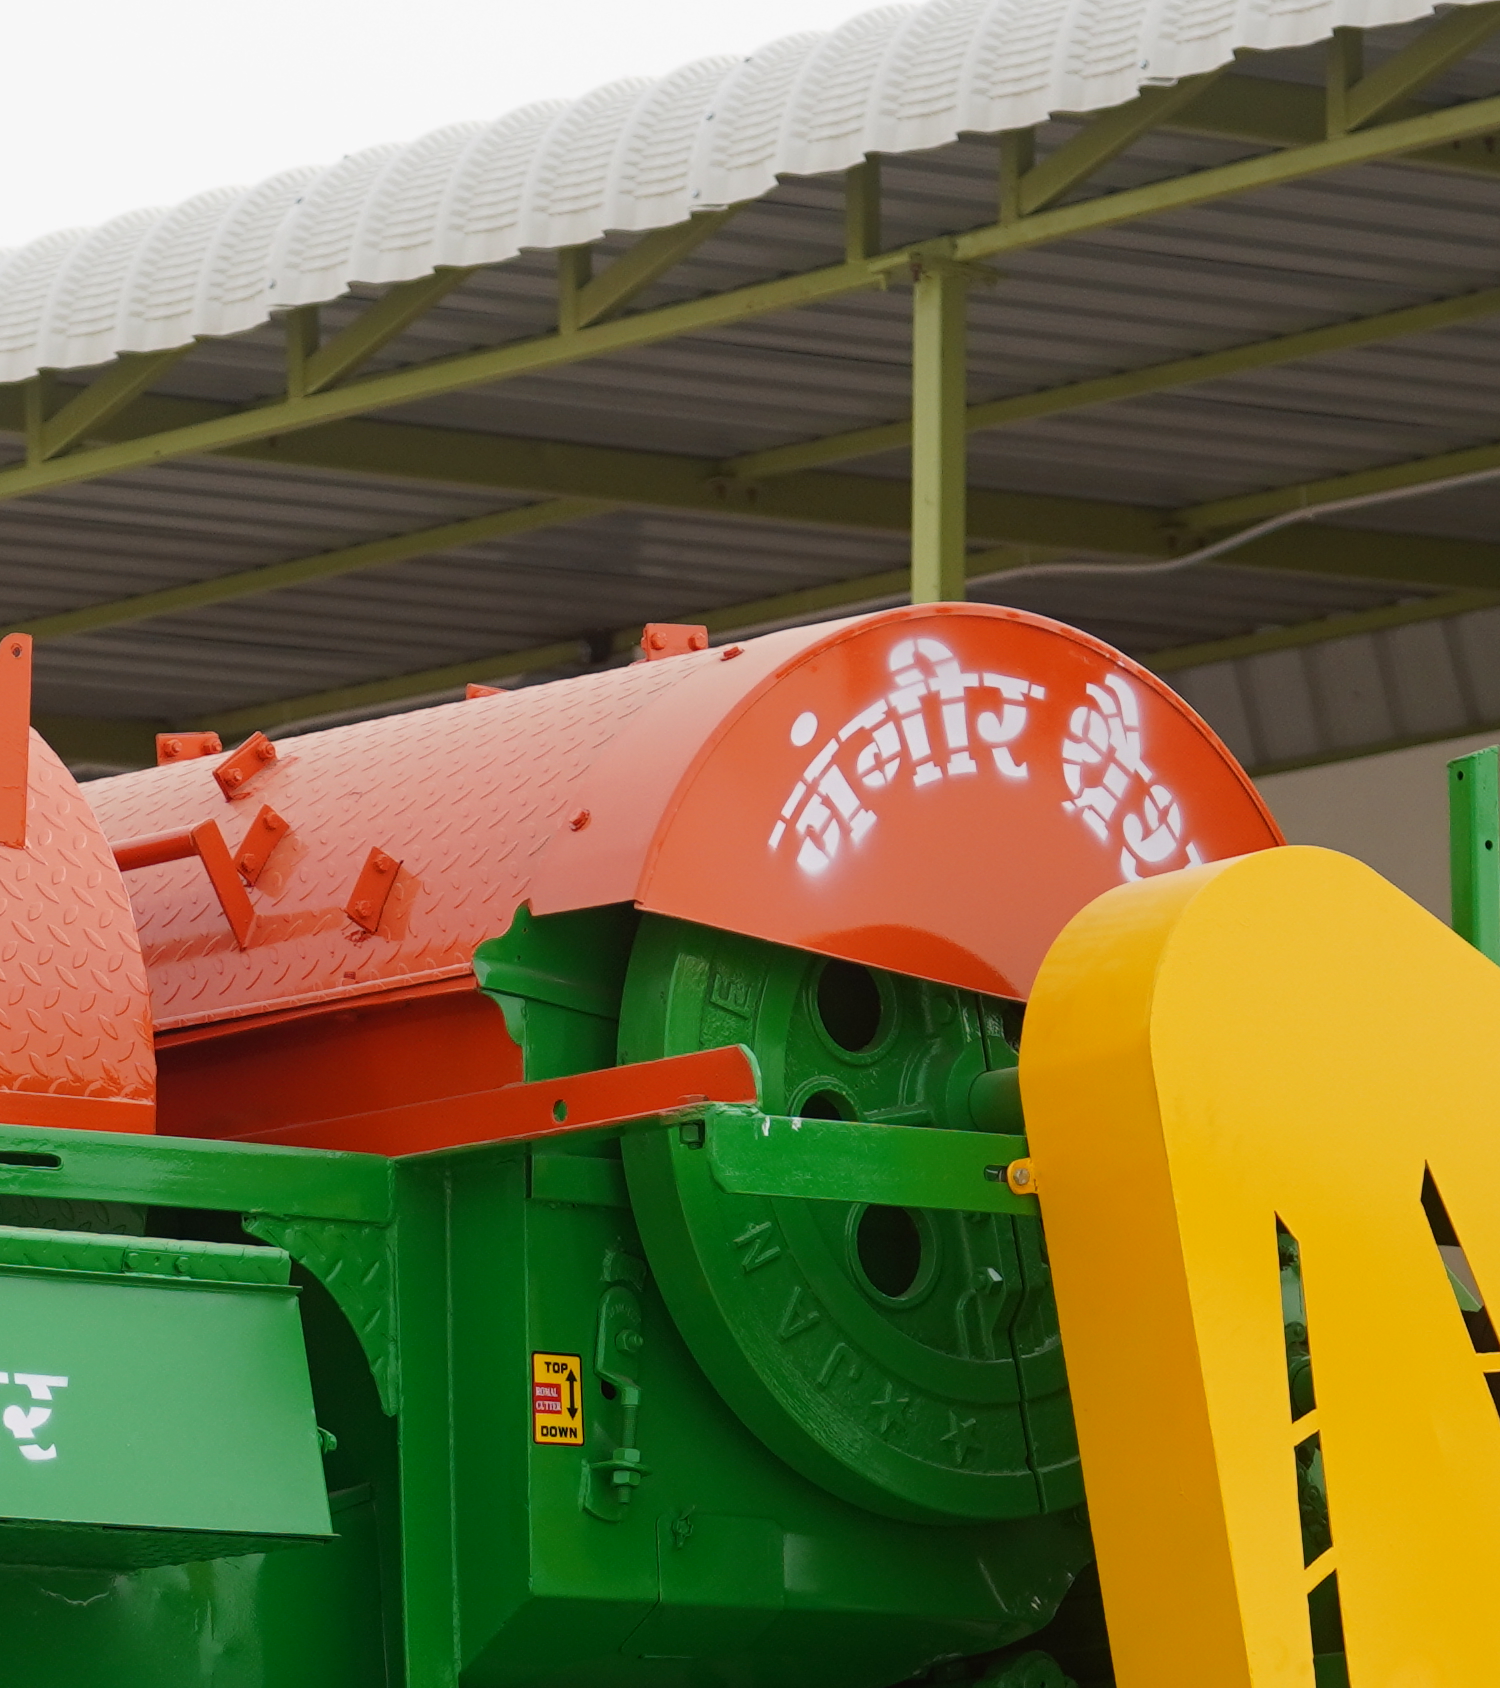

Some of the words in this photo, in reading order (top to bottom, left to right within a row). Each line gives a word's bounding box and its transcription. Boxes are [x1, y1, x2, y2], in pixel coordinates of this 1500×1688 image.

[768, 637, 1045, 878] जंगीर
[544, 1361, 569, 1374] TOP
[535, 1400, 562, 1411] CUTTER
[541, 1425, 578, 1439] DOWN
